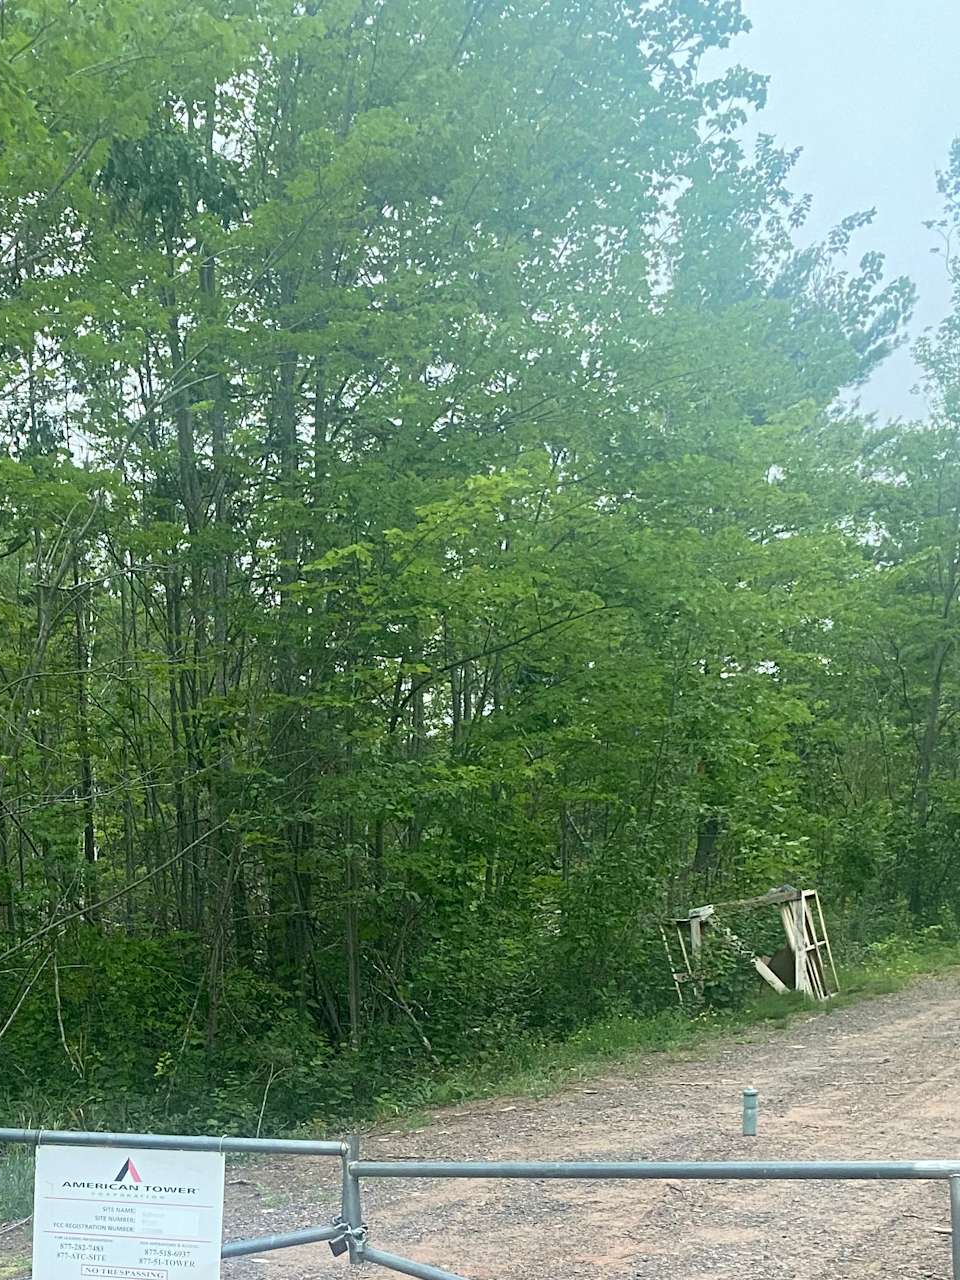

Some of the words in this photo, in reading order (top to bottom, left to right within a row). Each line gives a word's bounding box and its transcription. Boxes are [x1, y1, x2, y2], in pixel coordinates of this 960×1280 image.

[61, 1181, 139, 1191] AMERICAN
[144, 1185, 196, 1194] TOWER
[65, 1223, 107, 1231] REGISTRATION
[139, 1258, 195, 1267] 877-51-TOWER
[101, 1268, 164, 1279] TRESPASSING
